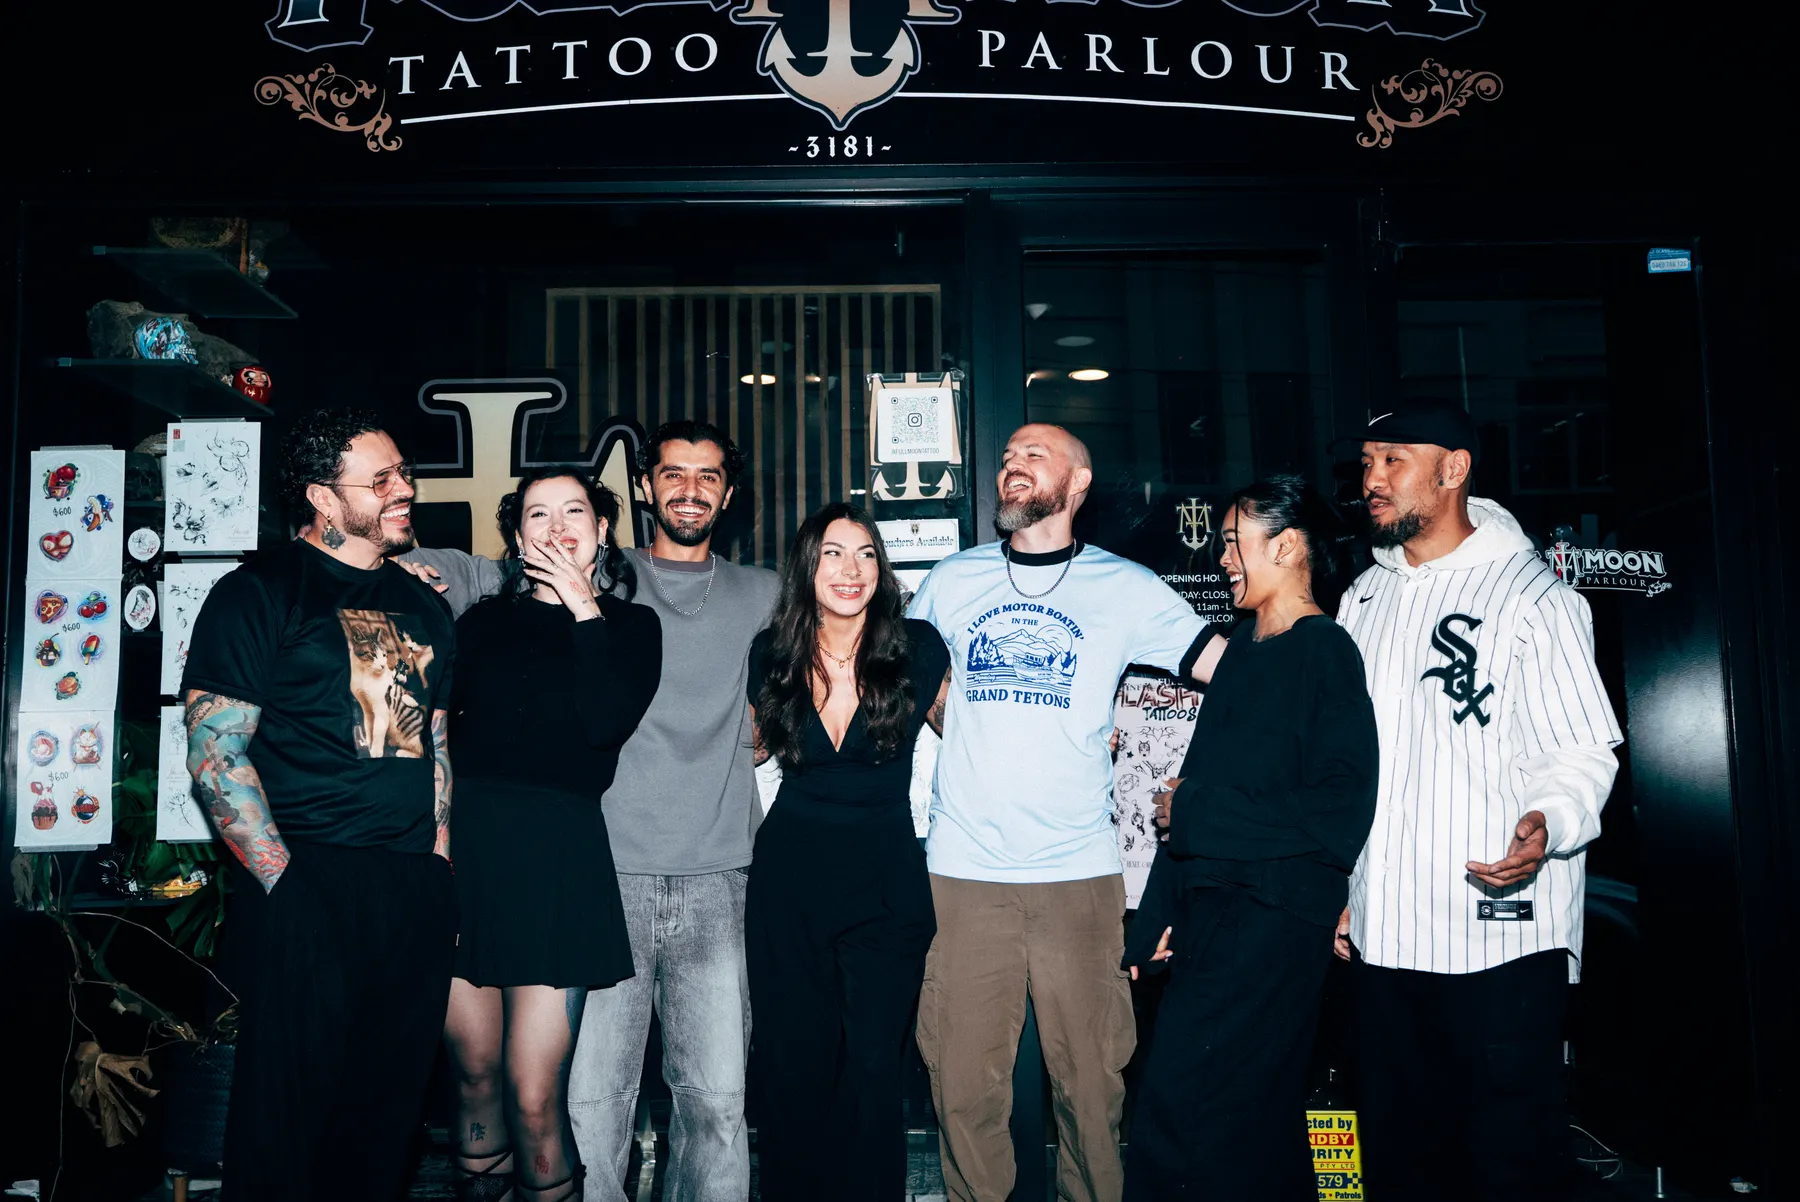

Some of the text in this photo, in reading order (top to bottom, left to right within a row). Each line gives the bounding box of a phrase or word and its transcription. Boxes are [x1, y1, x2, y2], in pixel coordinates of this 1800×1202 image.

[388, 29, 1360, 95] TATTOO PARLOUR
[52, 506, 72, 518] $600
[916, 535, 954, 547] Available
[1582, 548, 1665, 576] MOON
[1159, 574, 1201, 583] OPENING
[1586, 576, 1647, 588] PARLOUR
[1196, 602, 1220, 612] 11am
[967, 627, 975, 635] I
[972, 606, 1001, 629] LOVE
[1001, 602, 1045, 614] MOTOR
[1011, 617, 1039, 627] IN THE
[62, 621, 81, 633] $600
[965, 688, 1071, 710] GRAND TETONS
[48, 771, 69, 782] $600
[1337, 1117, 1353, 1132] by
[1317, 1174, 1343, 1188] 579
